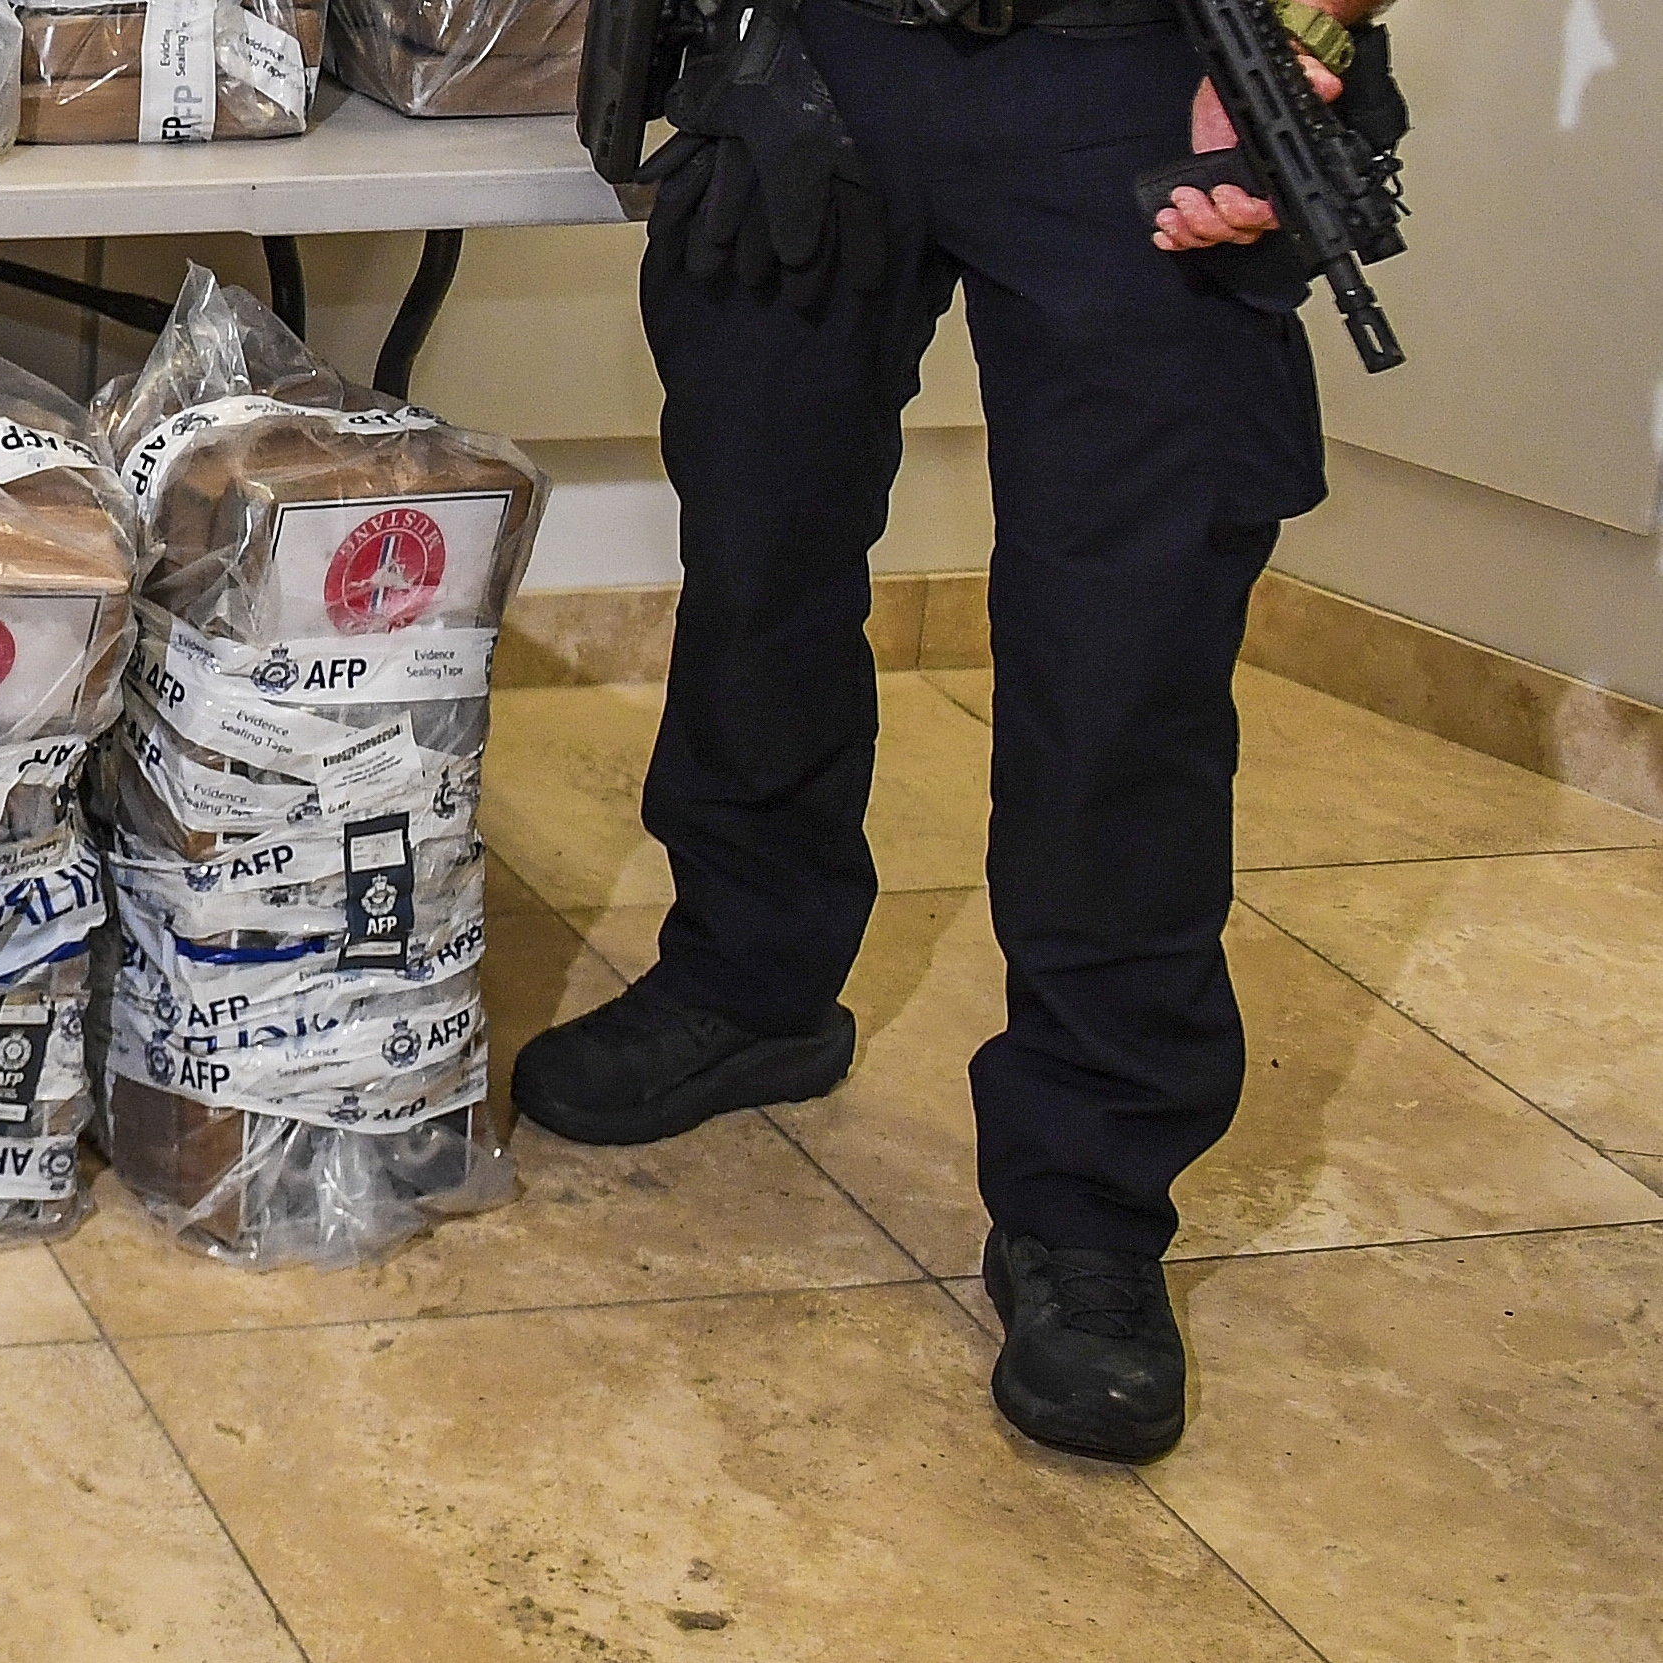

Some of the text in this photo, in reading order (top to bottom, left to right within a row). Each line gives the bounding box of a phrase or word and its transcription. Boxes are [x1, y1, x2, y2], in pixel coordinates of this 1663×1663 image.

[162, 115, 191, 141] FP
[130, 435, 167, 497] AFP
[303, 648, 456, 691] AFP Evidence
[406, 664, 464, 679] Sealing Tape
[146, 662, 290, 738] AFP Evidence
[220, 720, 294, 755] Sealing Tape
[192, 784, 248, 805] Evidence
[229, 844, 296, 880] AFP
[366, 915, 398, 935] AFP
[437, 924, 484, 967] AFP
[187, 994, 251, 1029] AFP
[427, 1008, 471, 1051] AFP
[179, 1057, 231, 1094] AFP
